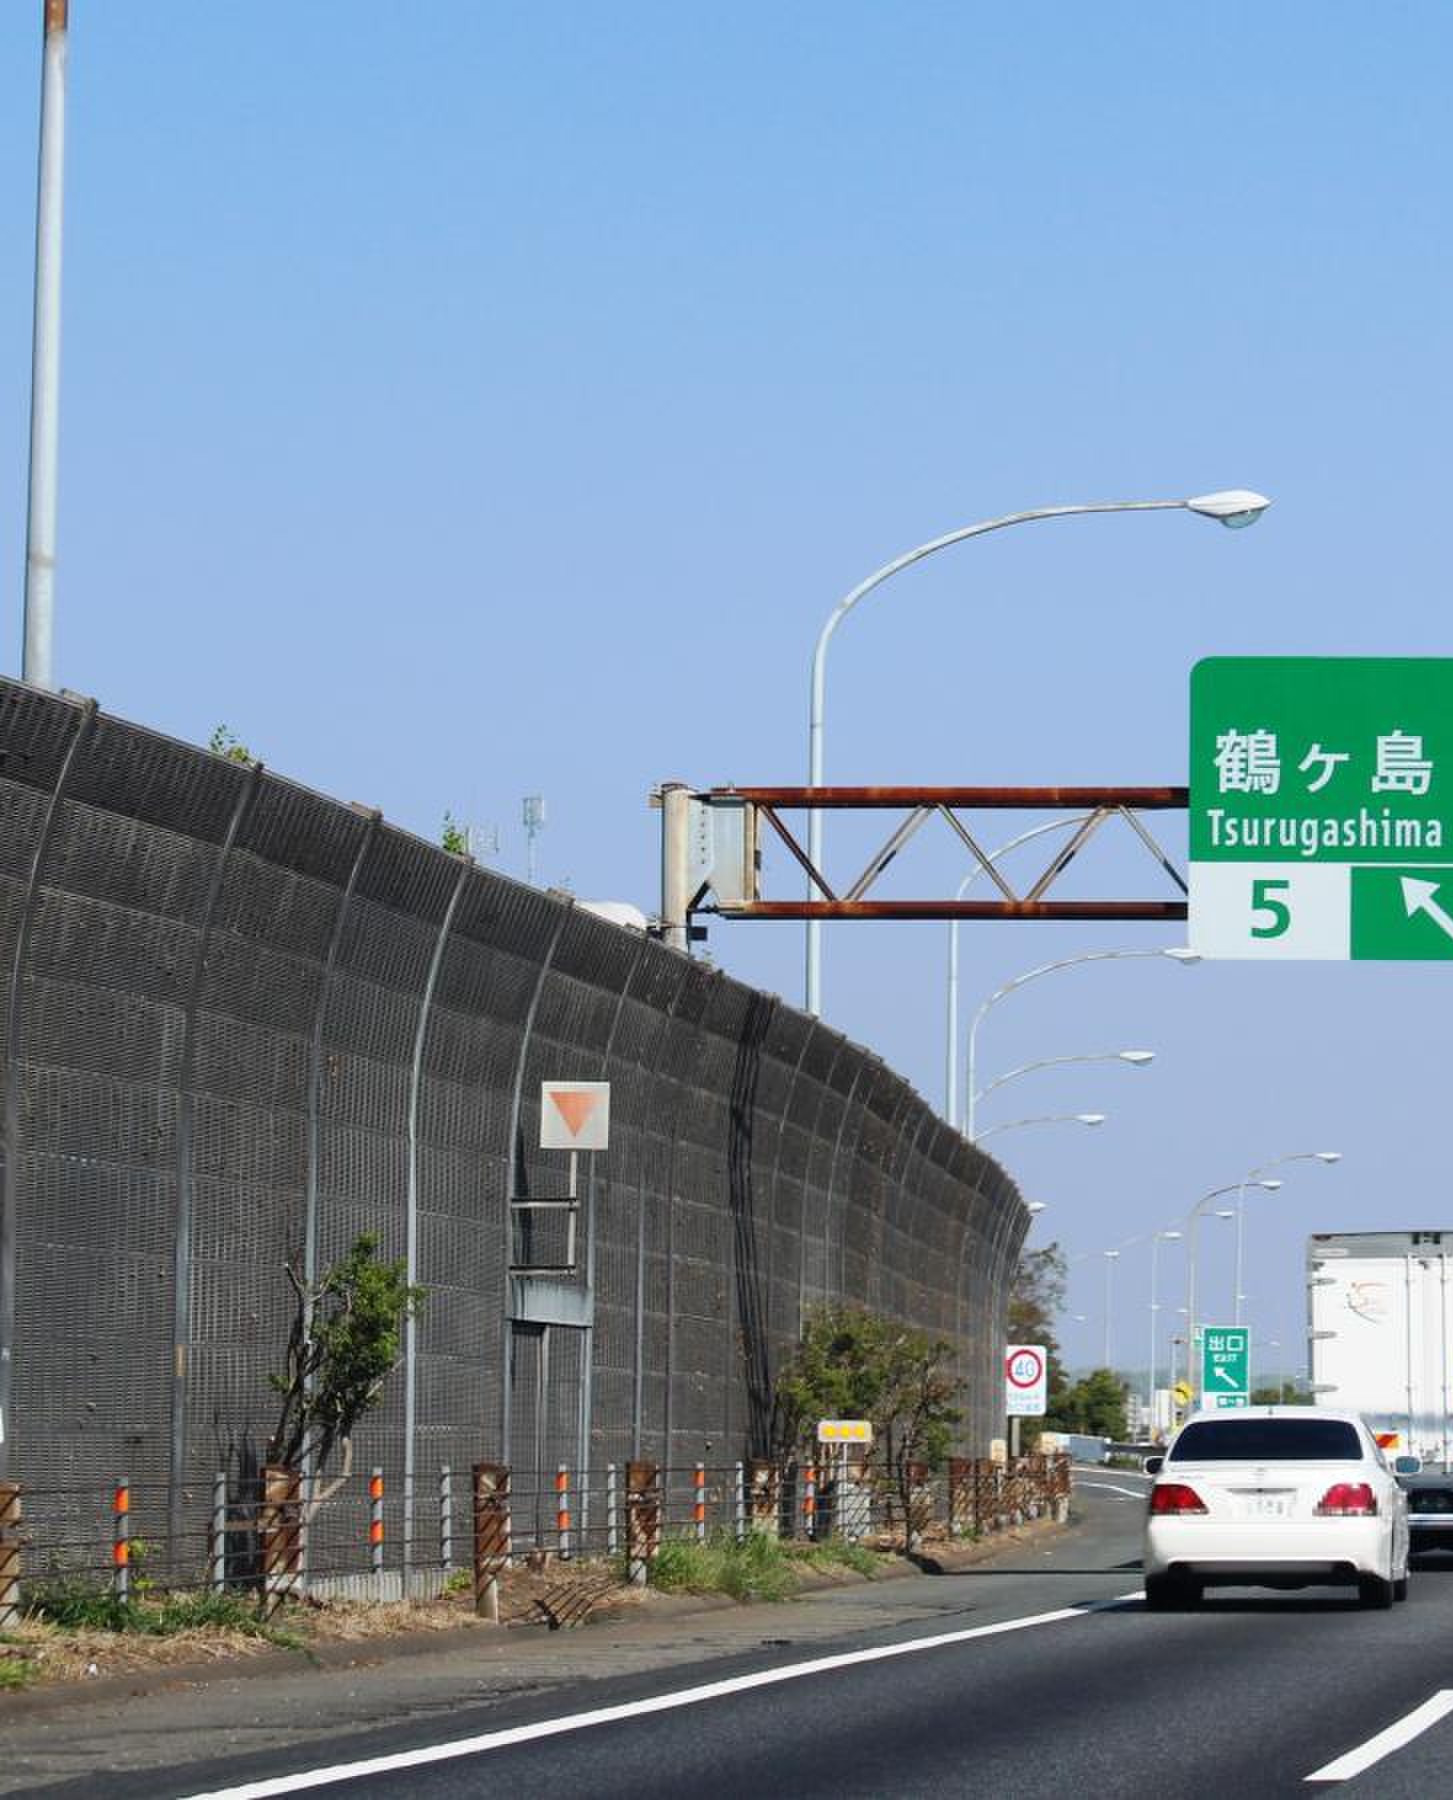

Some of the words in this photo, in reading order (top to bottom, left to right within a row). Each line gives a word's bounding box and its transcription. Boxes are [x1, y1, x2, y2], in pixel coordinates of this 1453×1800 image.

[1207, 808, 1442, 856] Tsurugashima
[1250, 879, 1291, 939] 5
[1208, 1336, 1244, 1351] 出口
[1015, 1359, 1035, 1377] 40
